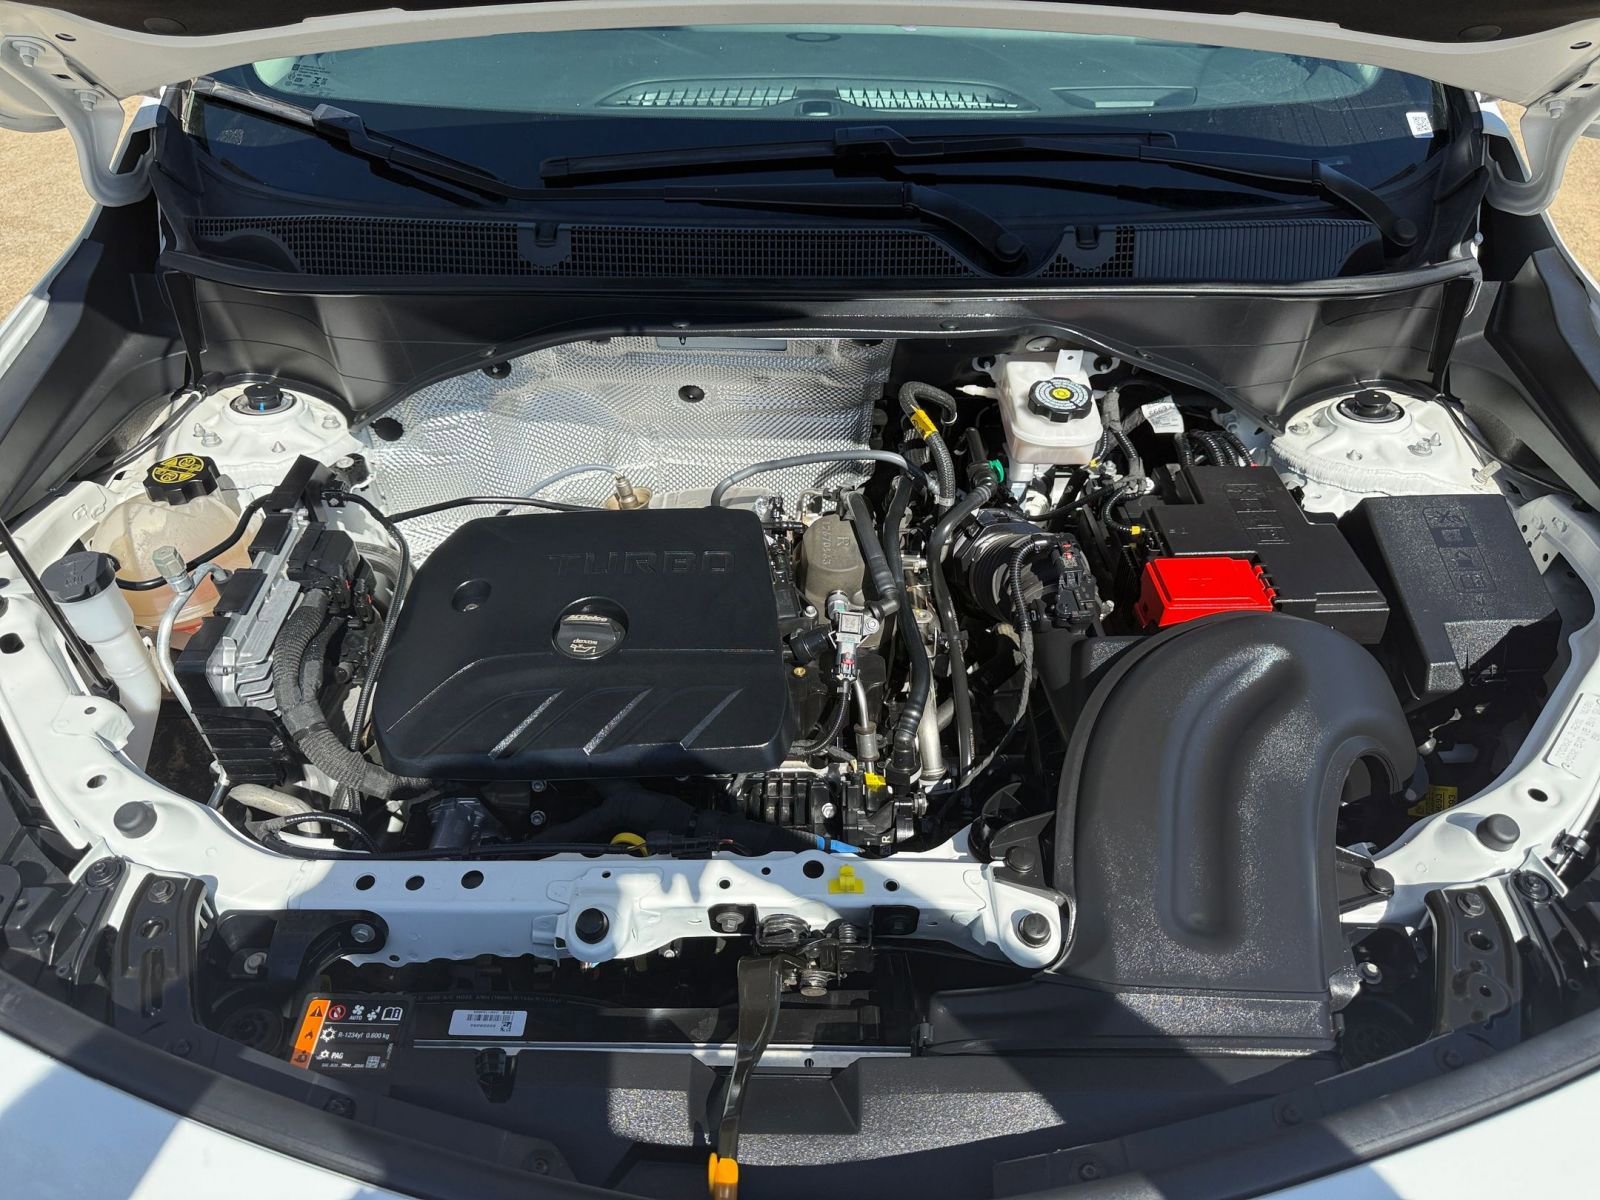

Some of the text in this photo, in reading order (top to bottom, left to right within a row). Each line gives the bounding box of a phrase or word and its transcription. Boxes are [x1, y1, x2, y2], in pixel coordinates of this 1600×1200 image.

[544, 551, 736, 576] TURBO
[564, 614, 608, 622] ACDelco
[881, 835, 891, 843] R
[337, 1031, 364, 1040] R-1234yf
[382, 1032, 390, 1040] kg
[330, 1052, 344, 1060] PAG
